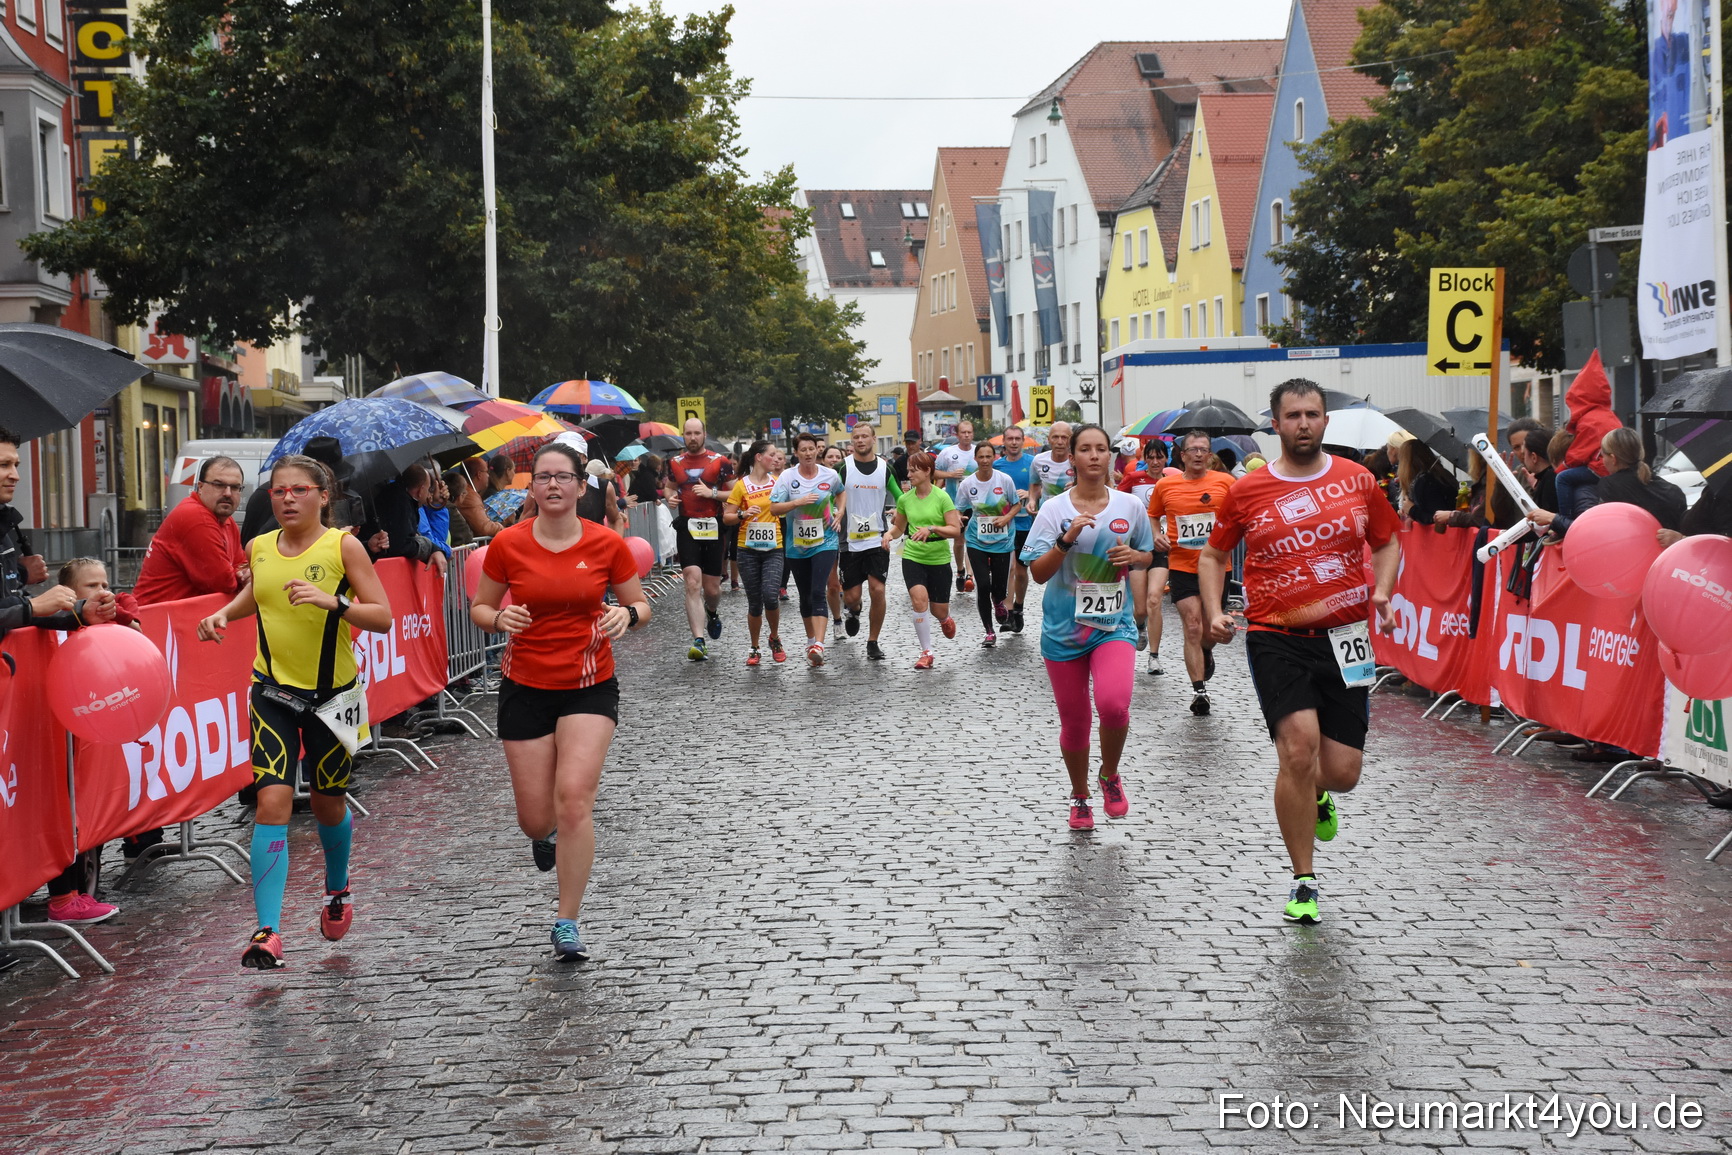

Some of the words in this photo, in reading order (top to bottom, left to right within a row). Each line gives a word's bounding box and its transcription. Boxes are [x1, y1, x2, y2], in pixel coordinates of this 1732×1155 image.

[1599, 230, 1619, 239] Ulmer
[1621, 227, 1641, 237] Gasse
[1439, 273, 1494, 291] Block
[1133, 288, 1149, 308] HOTEL
[1446, 300, 1484, 353] C
[1033, 387, 1052, 395] Block
[681, 399, 702, 407] Block
[1036, 398, 1049, 418] D
[1315, 472, 1375, 503] raum
[1277, 489, 1308, 507] raumbox
[697, 522, 708, 530] 31
[749, 529, 774, 540] 2683
[799, 526, 818, 538] 345
[858, 521, 870, 533] 25
[1181, 522, 1213, 538] 2124
[1082, 590, 1123, 613] 2470
[1340, 636, 1375, 664] 261
[110, 692, 142, 713] energie
